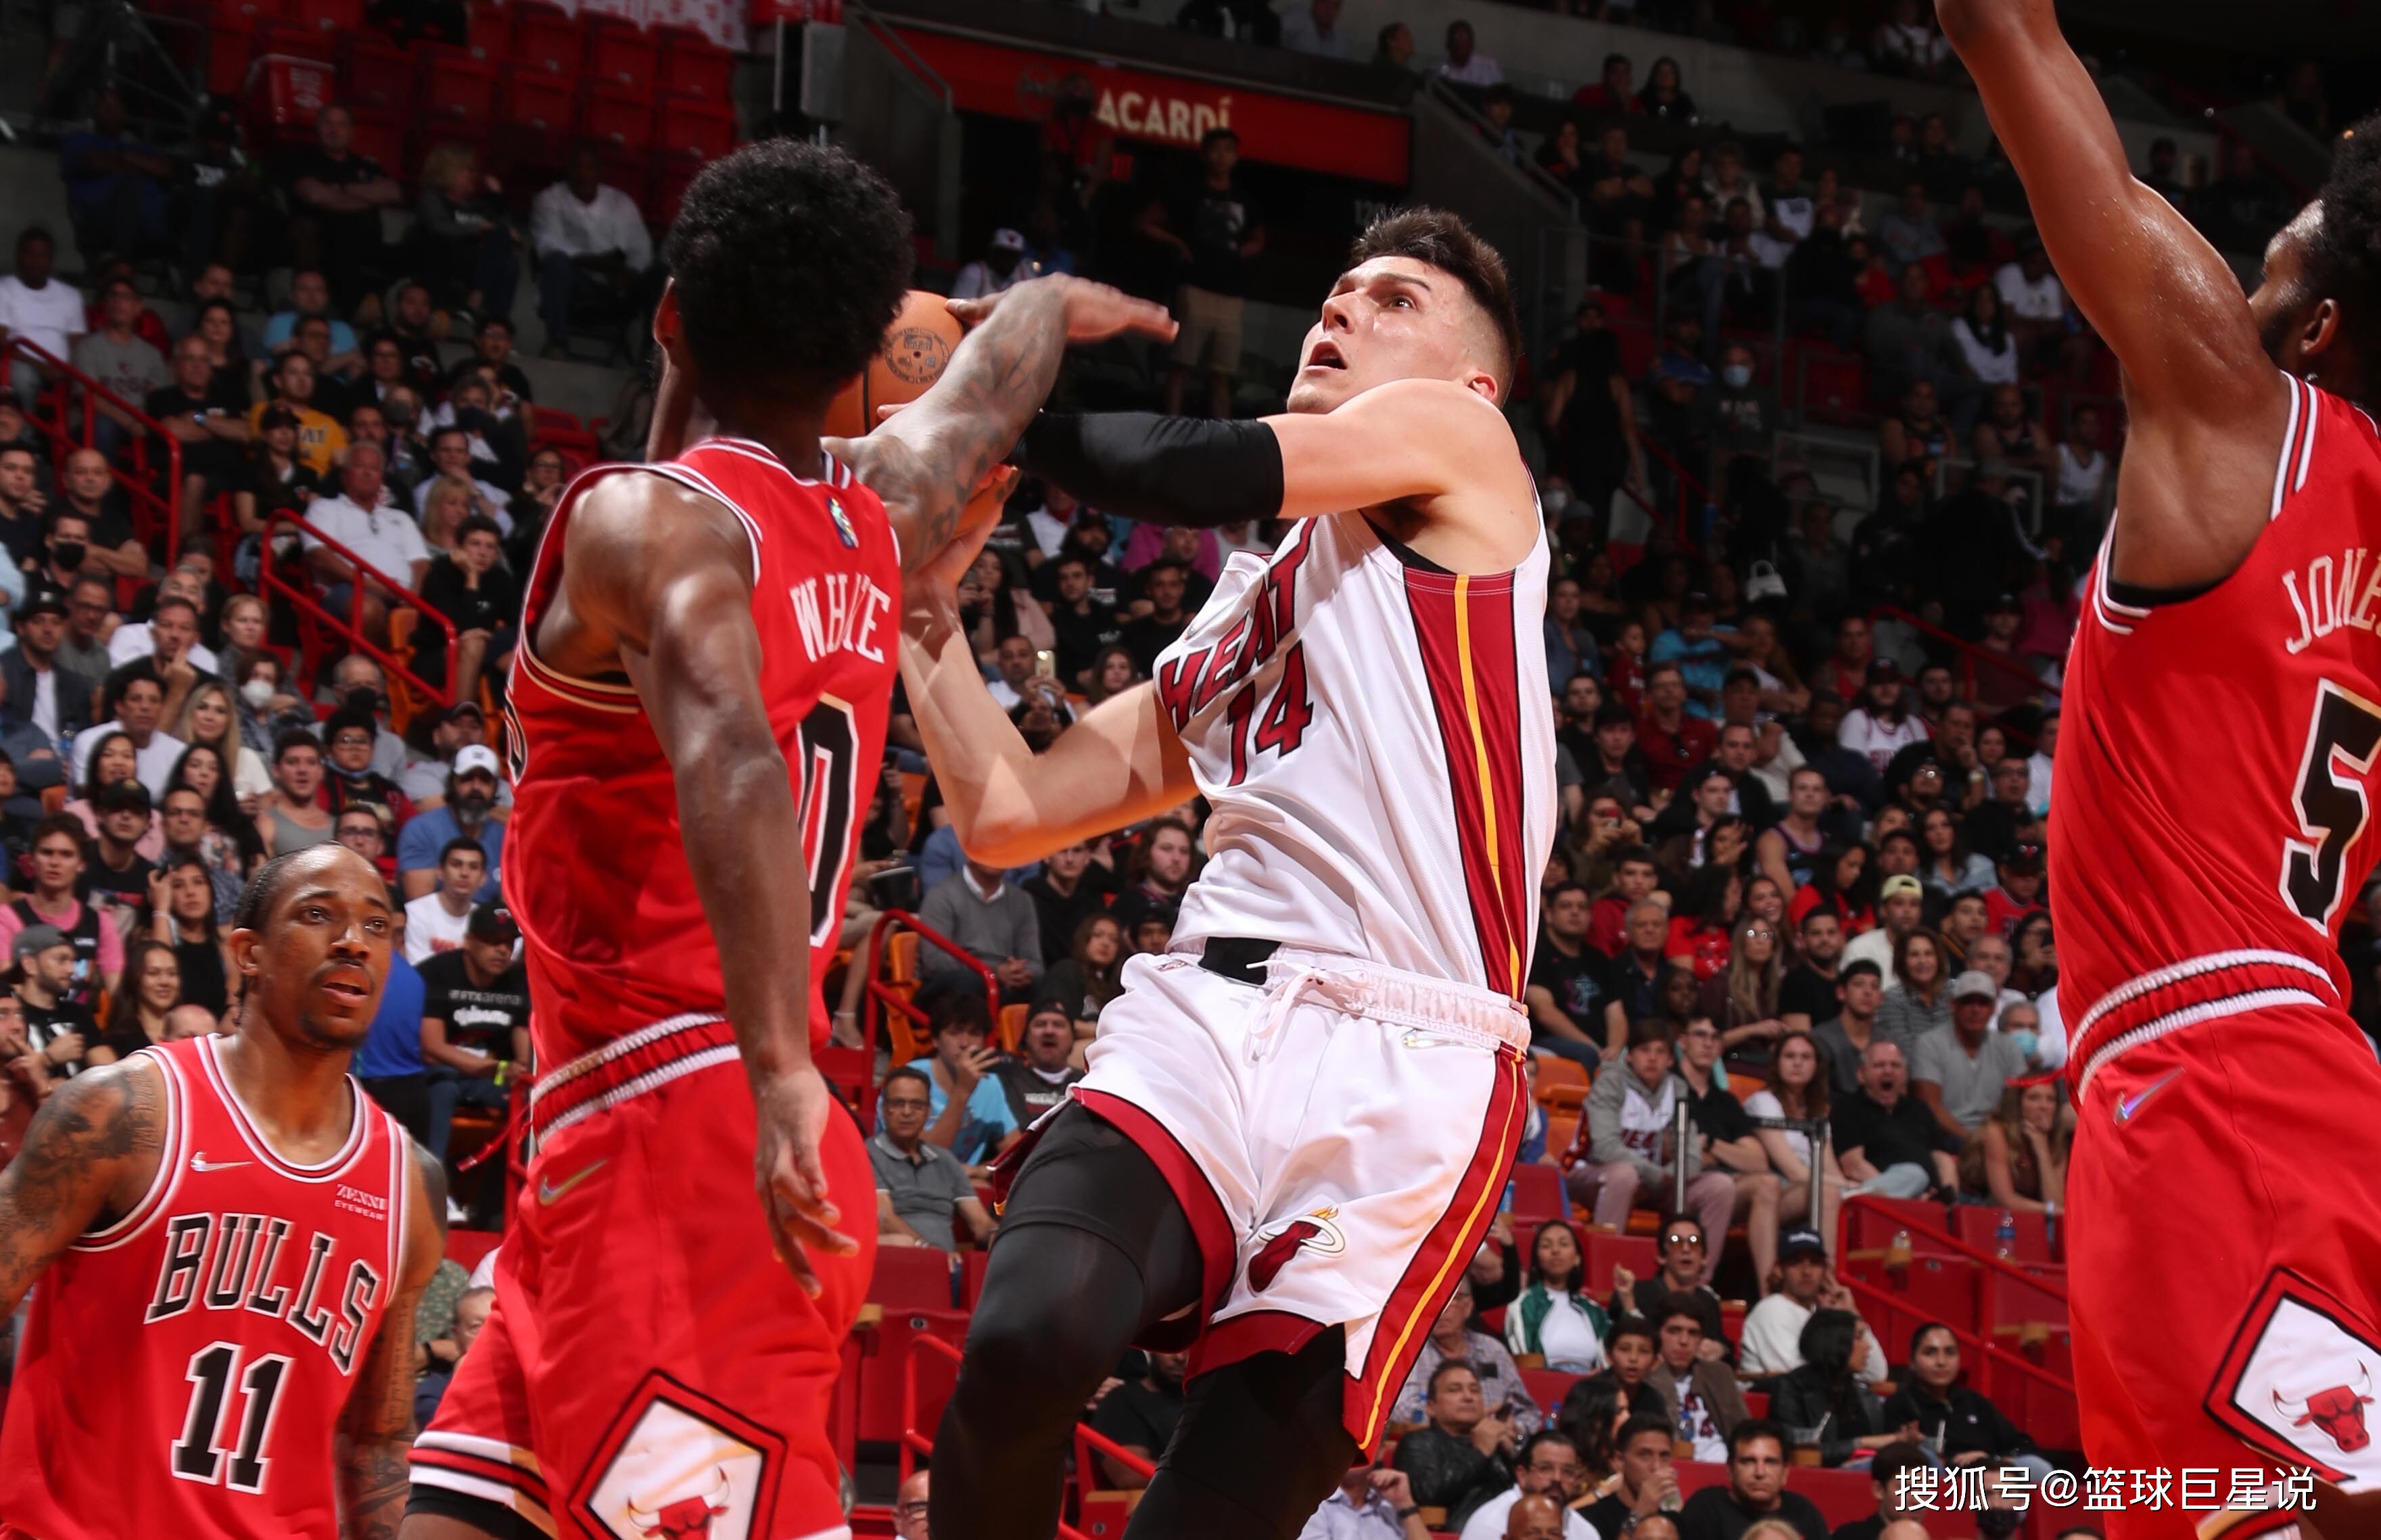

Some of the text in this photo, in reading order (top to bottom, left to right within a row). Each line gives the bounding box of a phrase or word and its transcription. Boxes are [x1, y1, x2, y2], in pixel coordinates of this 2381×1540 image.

[1095, 87, 1233, 144] ACARDÍ
[1159, 517, 1319, 736] HEAT
[2282, 547, 2381, 655] JONE
[1226, 639, 1315, 788] 14
[797, 691, 859, 948] 0
[2278, 677, 2381, 938] 5
[143, 1211, 385, 1377] BULLS
[170, 1340, 298, 1496] 11
